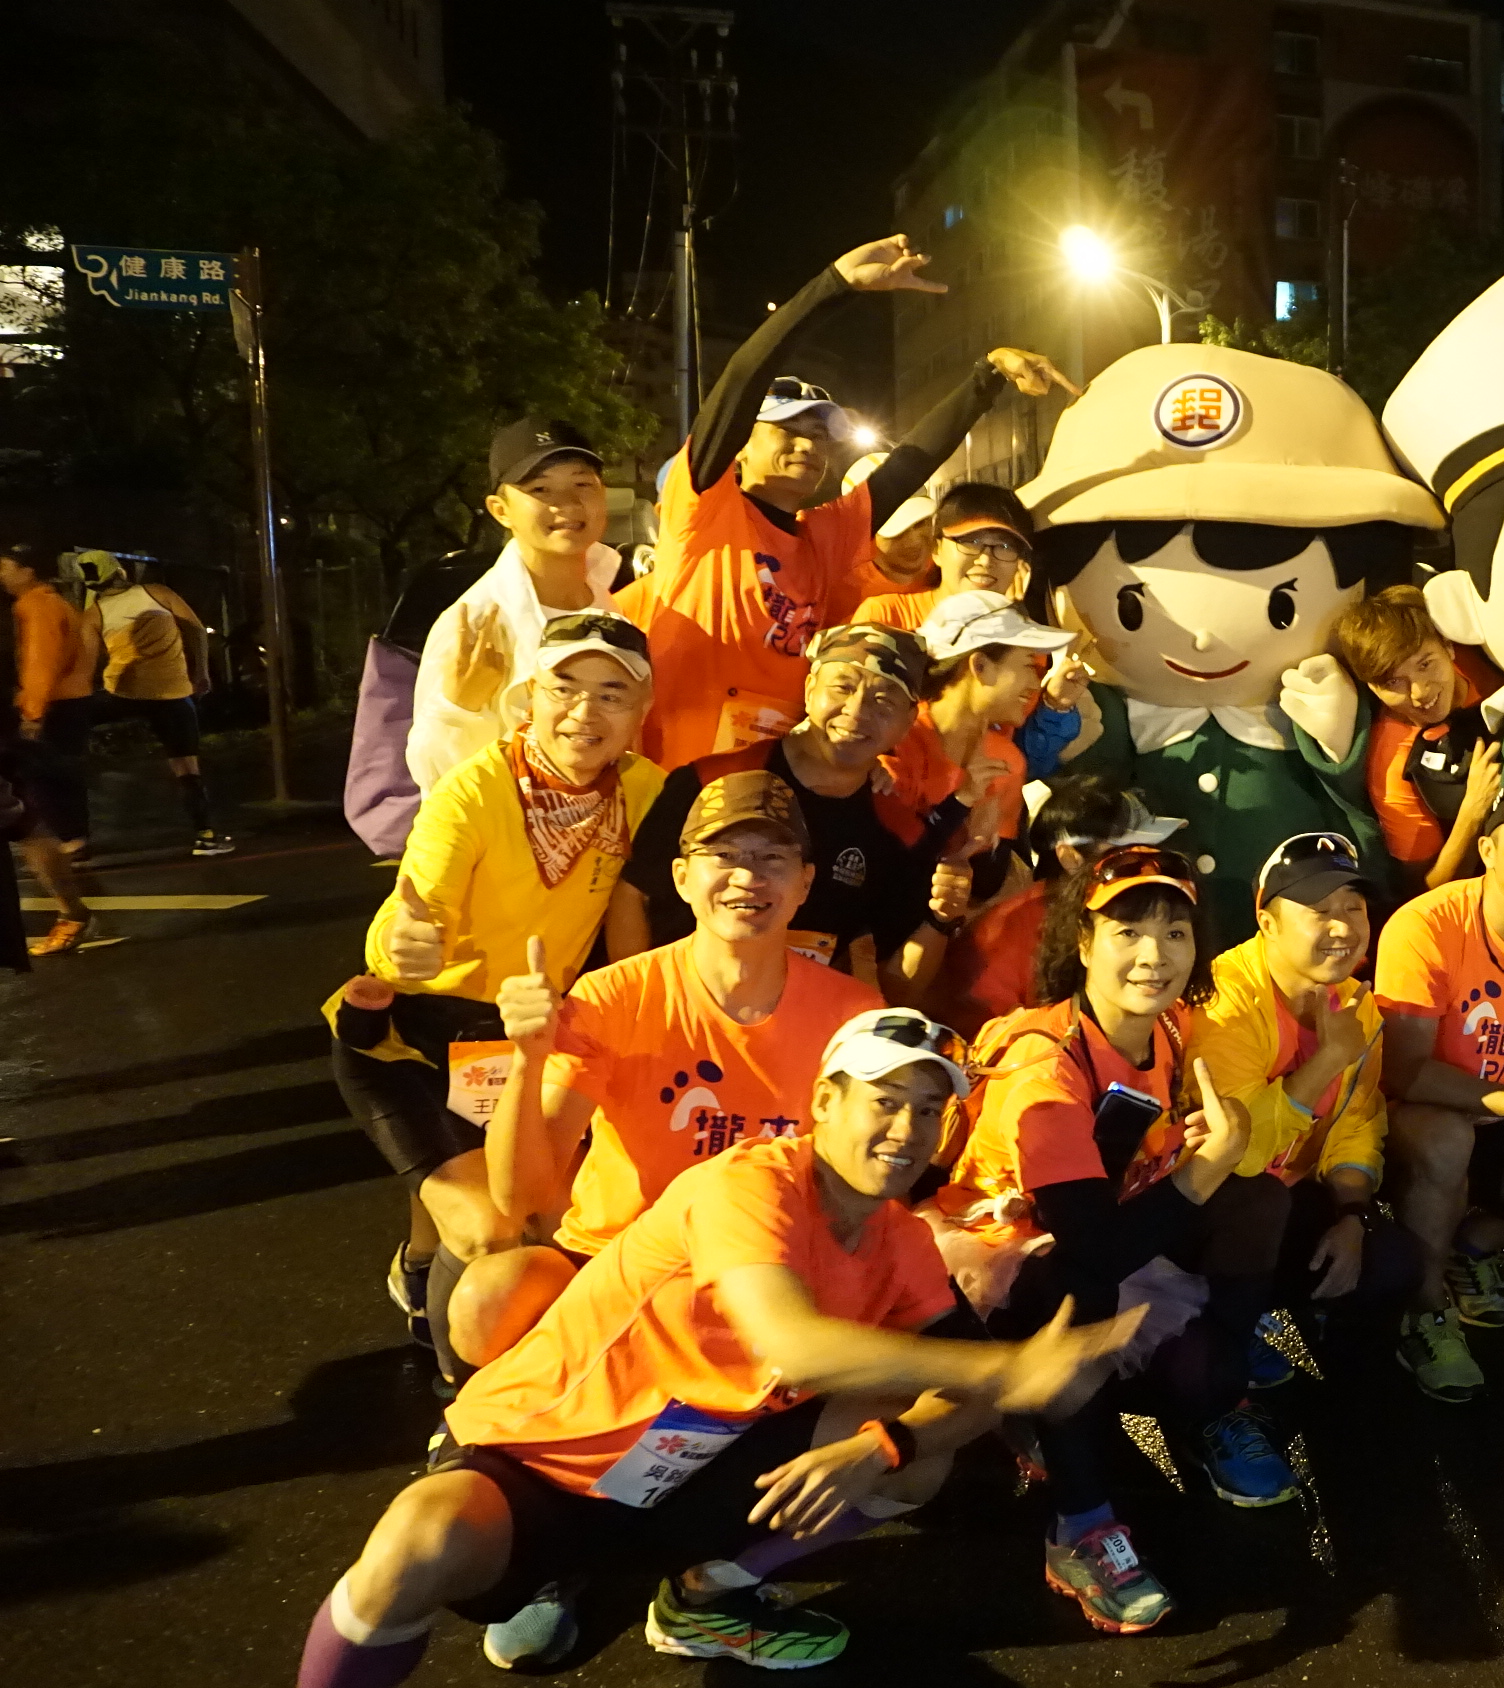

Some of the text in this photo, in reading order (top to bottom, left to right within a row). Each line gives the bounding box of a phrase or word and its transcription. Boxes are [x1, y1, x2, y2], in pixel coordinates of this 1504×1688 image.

[119, 254, 225, 281] 健康路
[124, 288, 225, 306] Jiankang Rd.
[1171, 388, 1222, 432] 郵
